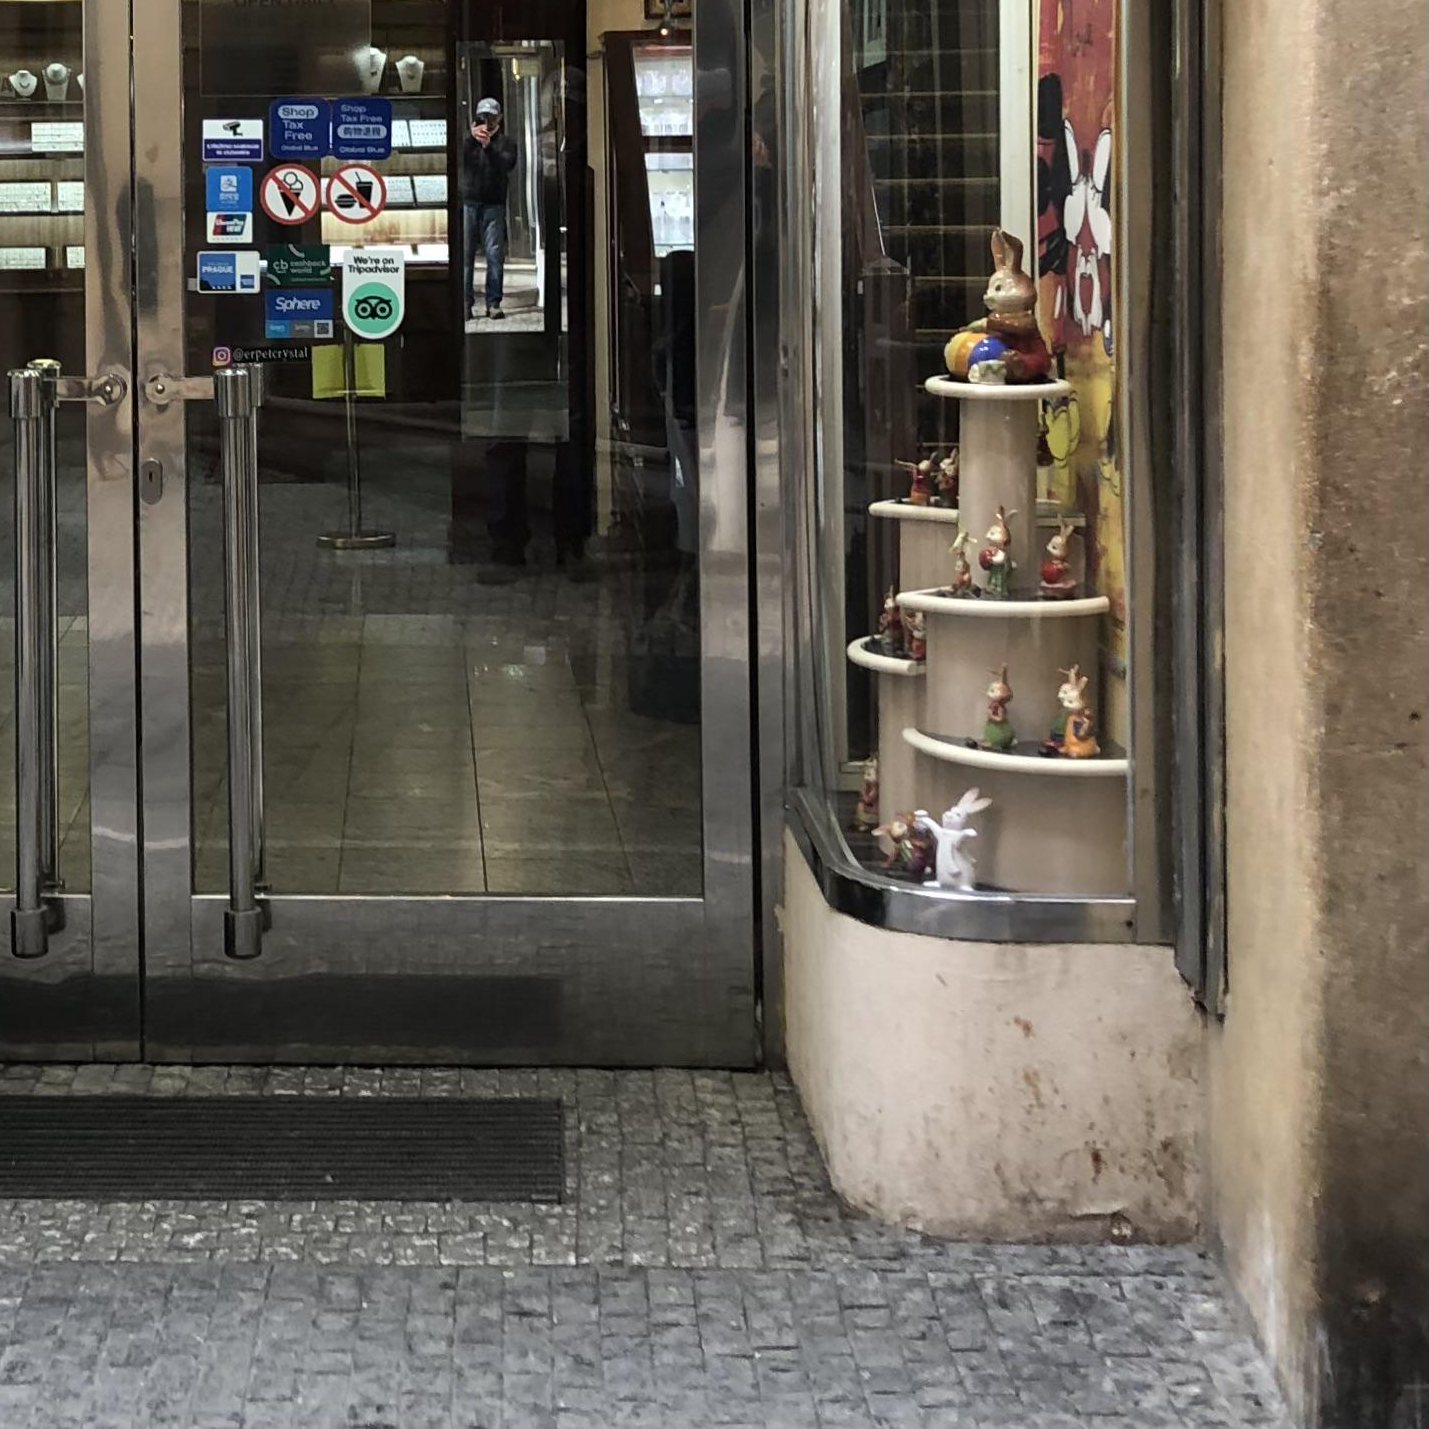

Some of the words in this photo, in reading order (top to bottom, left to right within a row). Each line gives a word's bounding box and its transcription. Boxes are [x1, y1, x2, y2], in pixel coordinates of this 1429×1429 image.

[281, 107, 315, 118] Shop
[340, 104, 367, 114] Shop
[340, 114, 358, 122] Tax
[360, 114, 383, 122] Free
[282, 120, 304, 130] Tax
[284, 131, 313, 141] Free
[353, 256, 380, 264] We're
[347, 264, 400, 275] Tripadvisor
[275, 296, 321, 312] Sphere
[233, 345, 309, 361] @erpetcrystal
